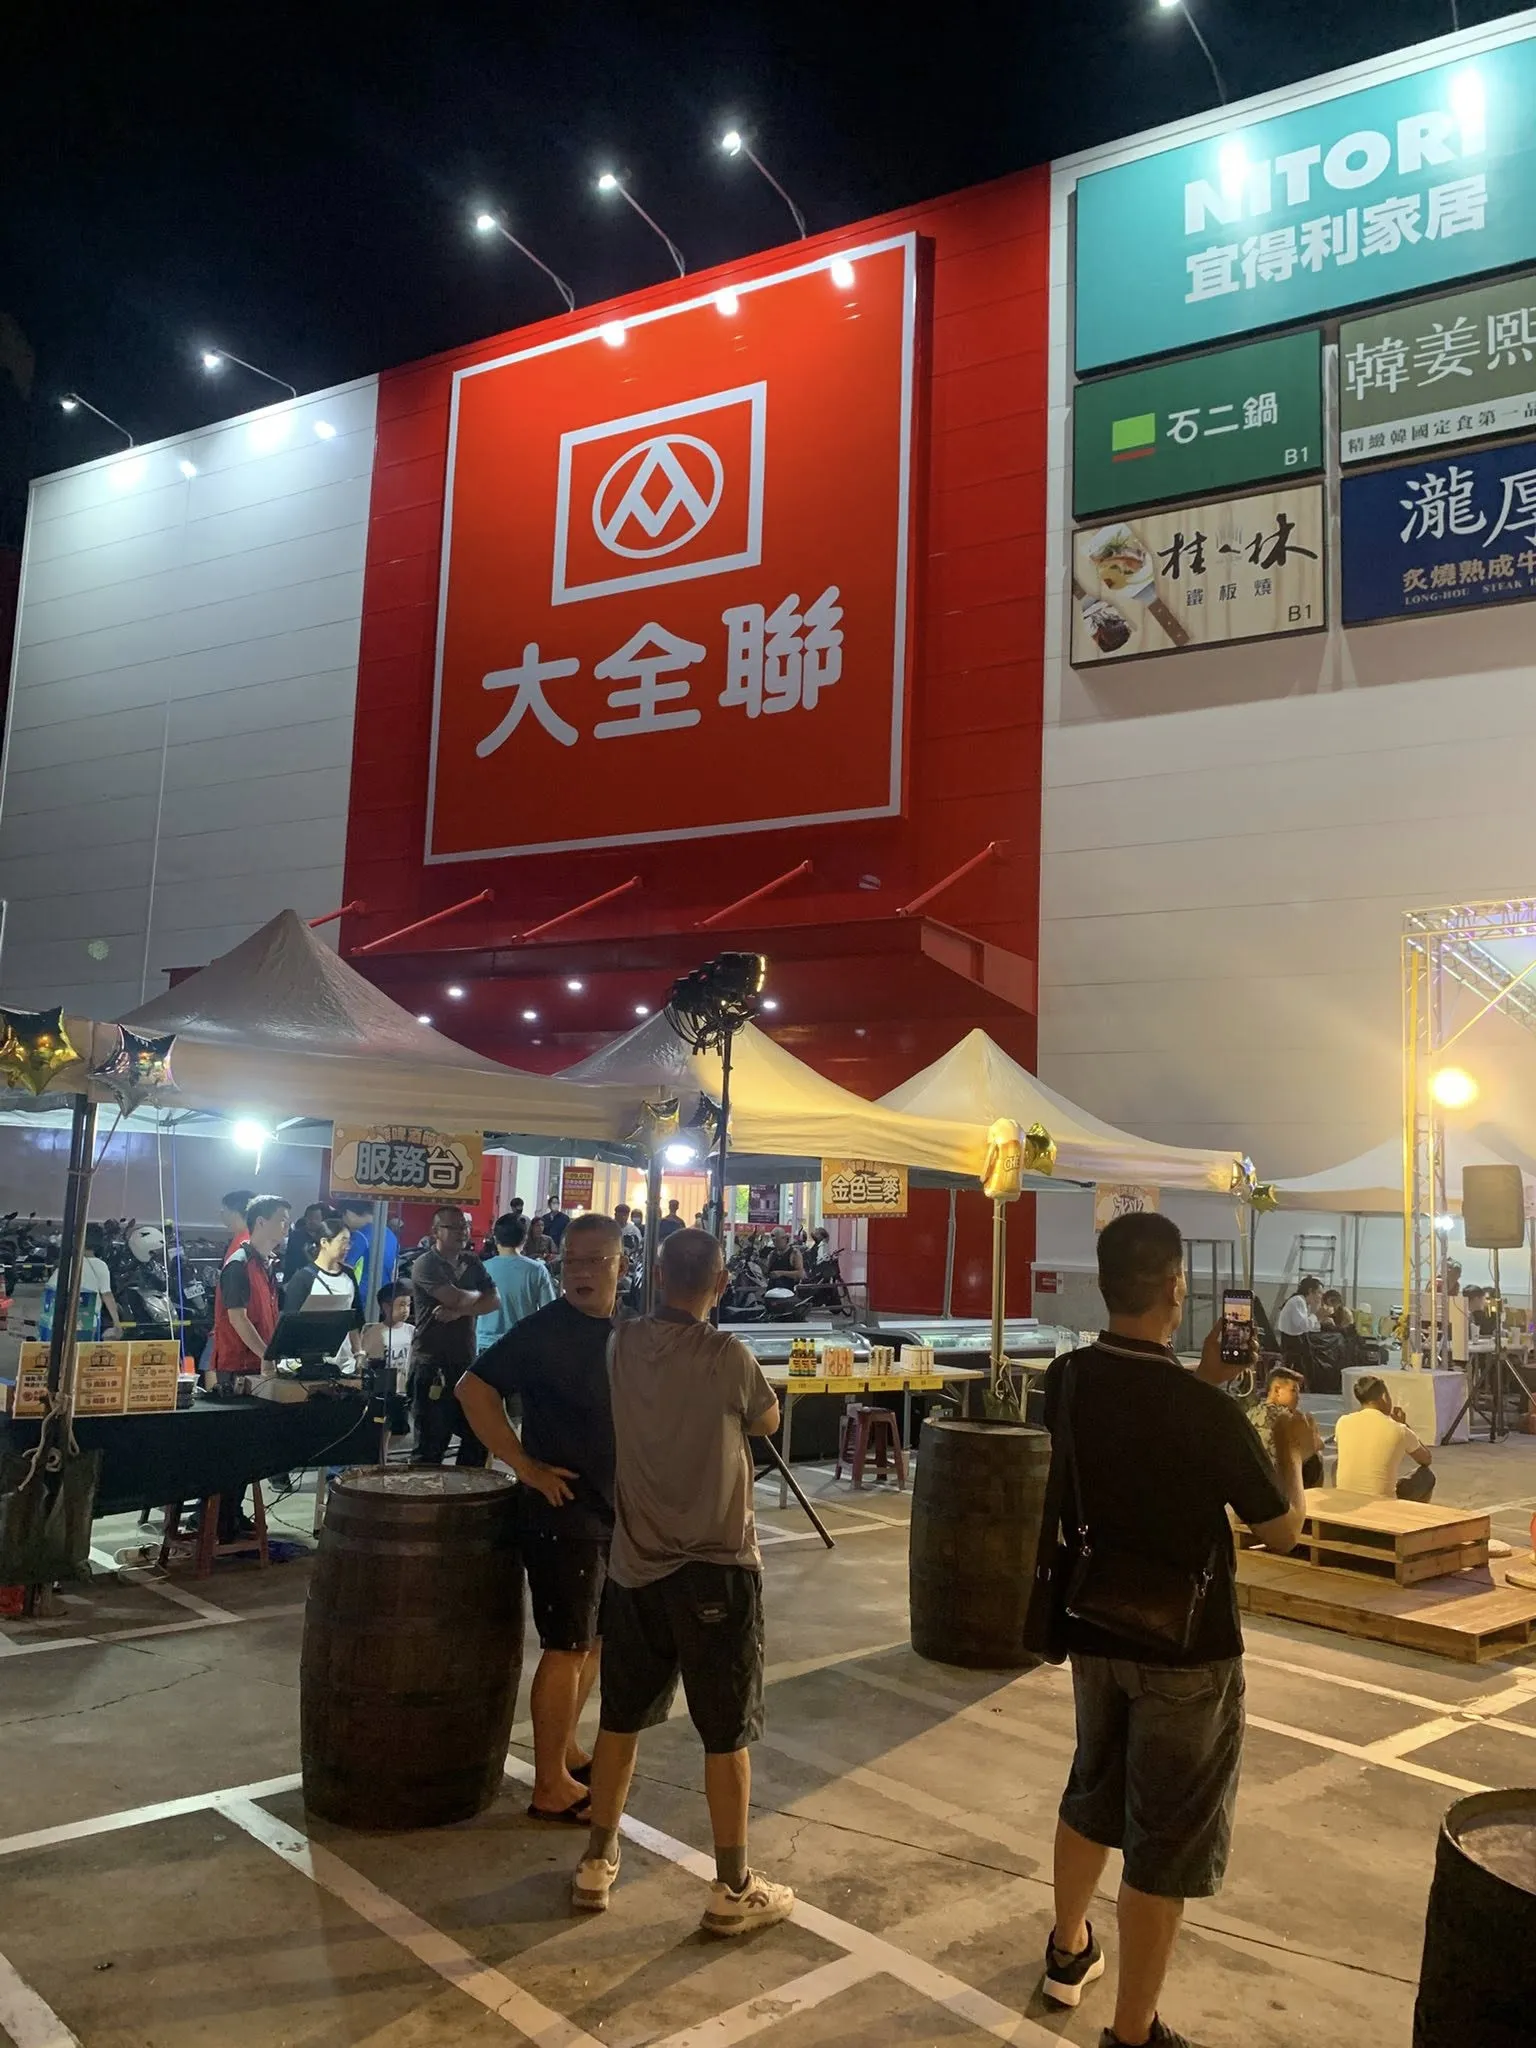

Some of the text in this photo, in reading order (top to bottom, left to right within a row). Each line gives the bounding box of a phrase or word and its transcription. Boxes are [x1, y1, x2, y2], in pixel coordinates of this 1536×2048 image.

[1184, 98, 1487, 236] NITORI
[1184, 174, 1488, 304] 宜得利家居
[1345, 306, 1536, 401] 韓姜熙
[1166, 391, 1278, 444] 石二鍋
[1284, 446, 1308, 466] B1
[1186, 577, 1272, 607] 鐵板燒
[1482, 579, 1522, 594] STEAK
[1288, 604, 1312, 623] B1
[476, 585, 844, 759] 大全聯
[356, 1142, 462, 1188] 服務台
[832, 1174, 900, 1204] 金色三麥
